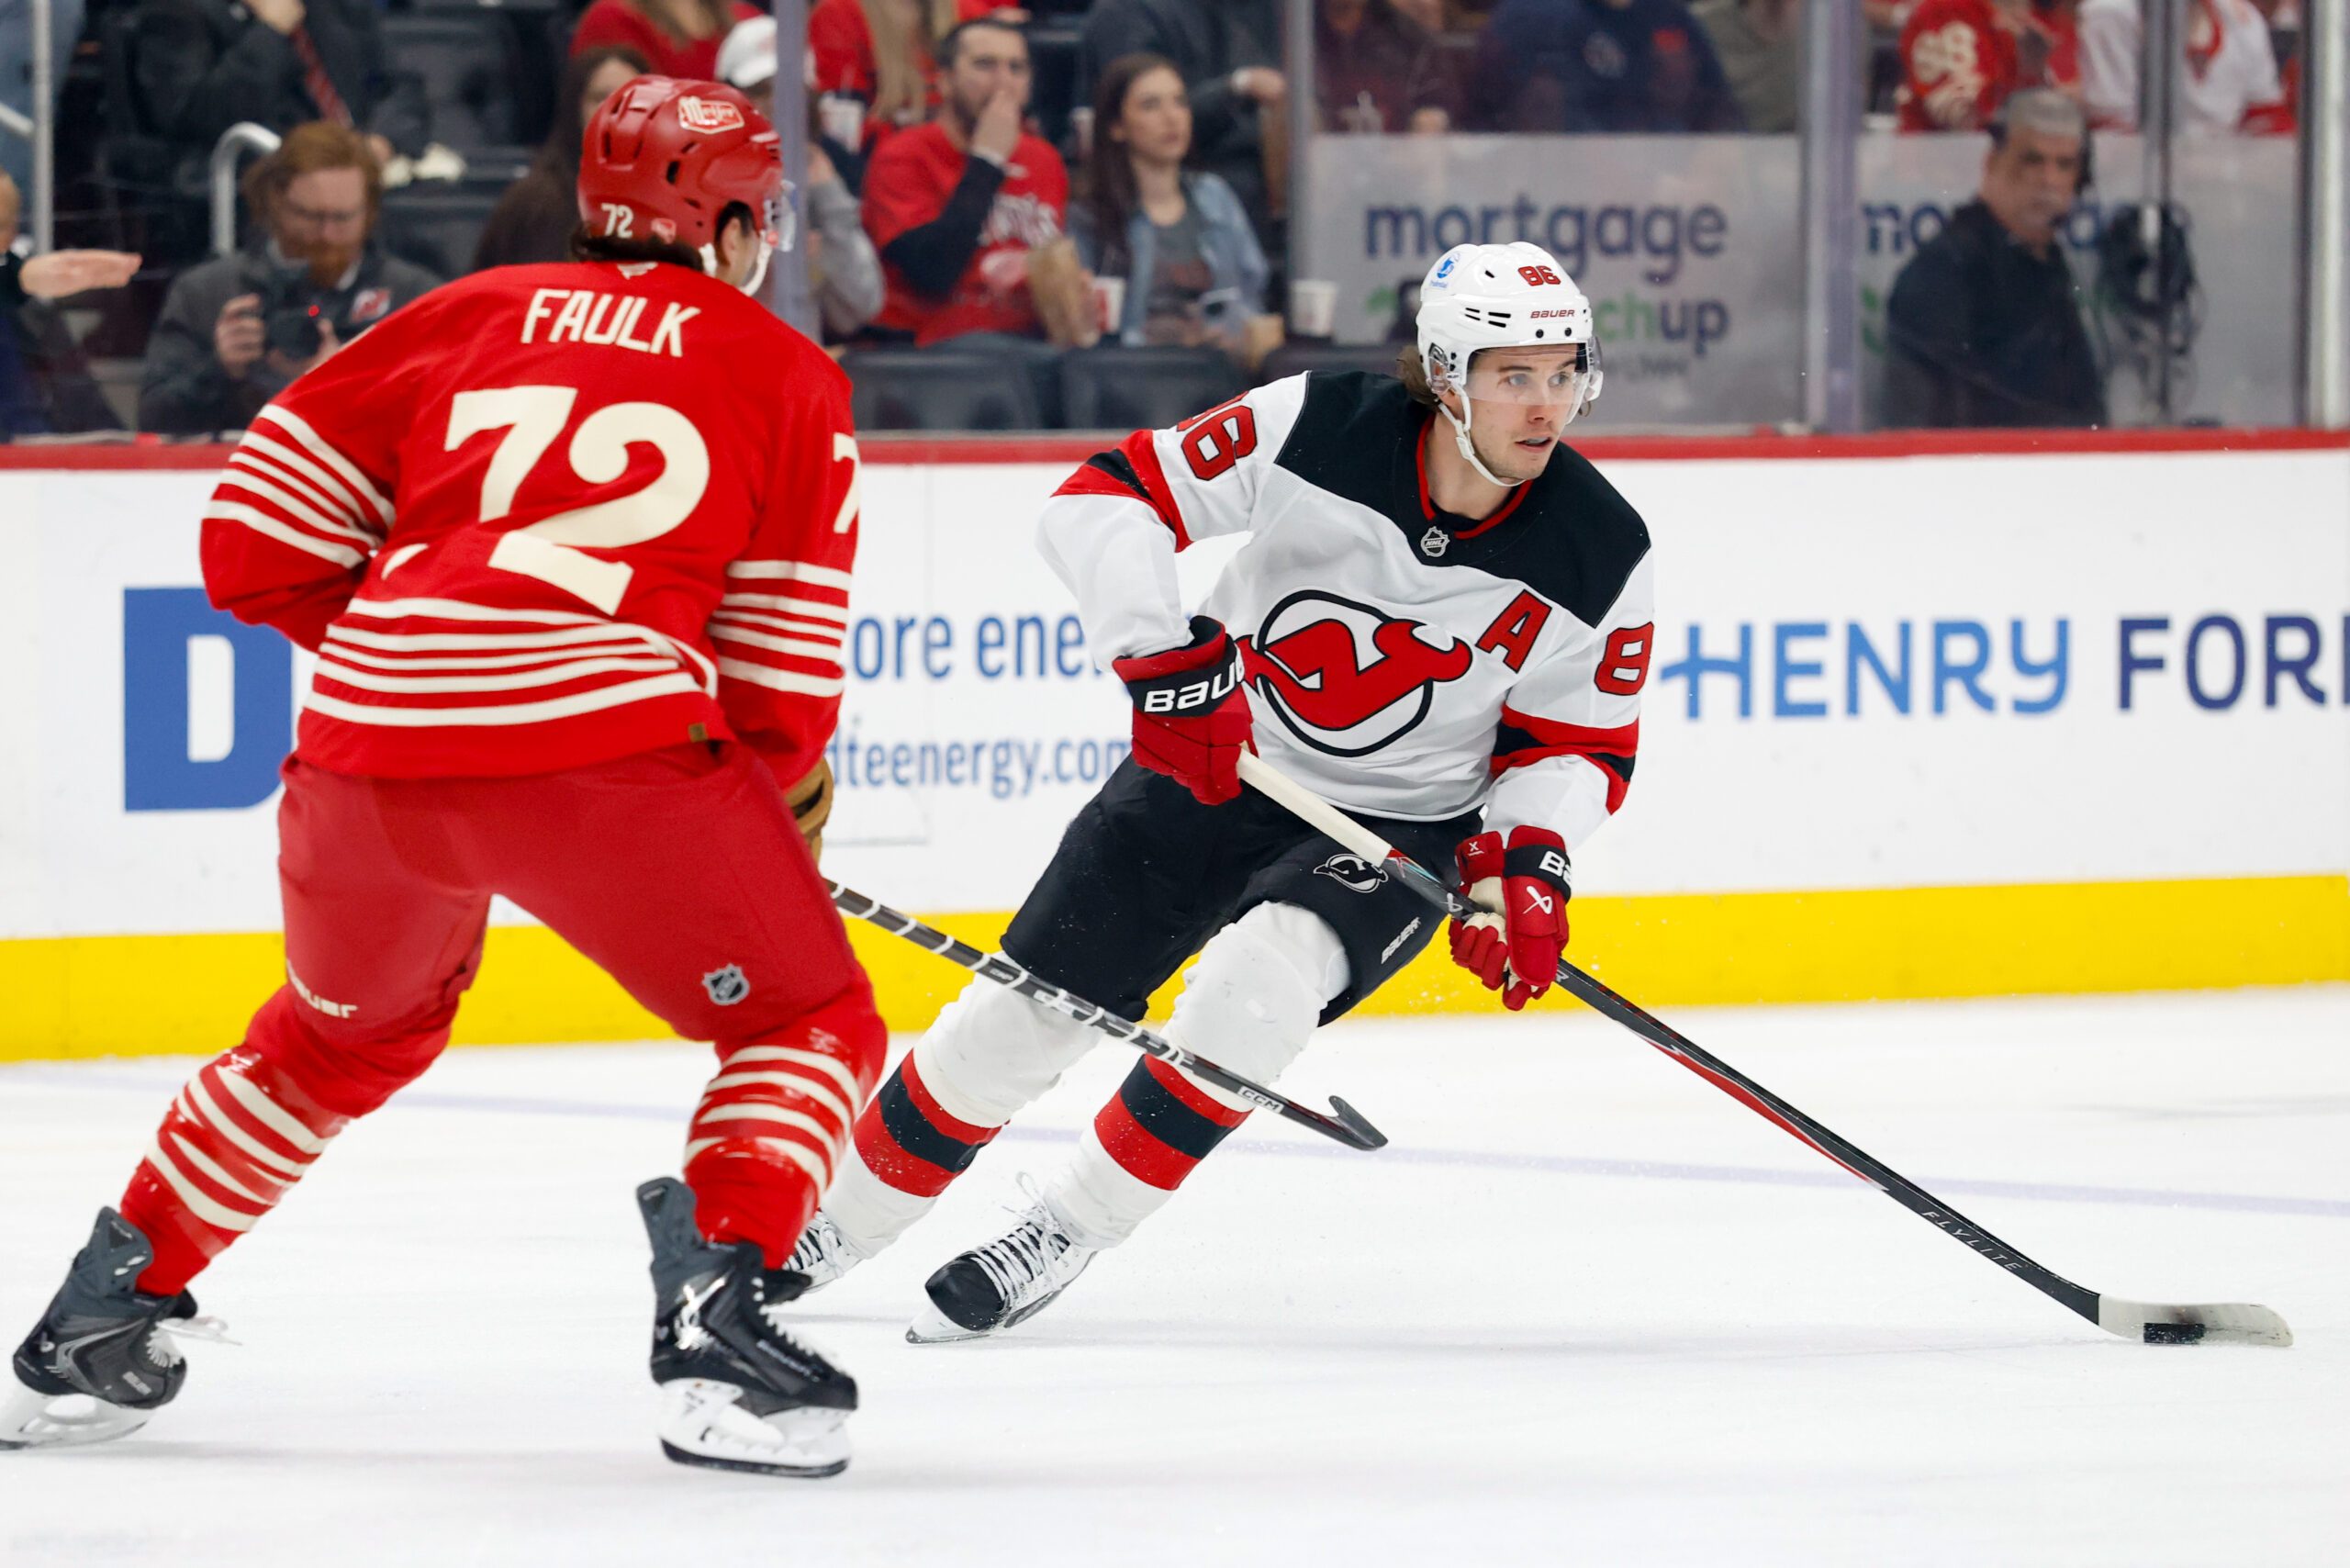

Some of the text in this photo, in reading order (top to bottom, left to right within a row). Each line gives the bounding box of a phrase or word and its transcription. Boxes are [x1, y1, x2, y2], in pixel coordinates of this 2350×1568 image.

[601, 202, 633, 239] 72
[1365, 193, 1728, 286] mortgage
[520, 287, 701, 358] FAULK
[1595, 290, 1732, 357] chup
[1176, 390, 1258, 481] 6
[444, 385, 711, 617] 72
[853, 614, 1104, 681] ore ene
[1475, 588, 1552, 674] A
[1594, 621, 1654, 696] 8
[1660, 613, 2350, 720] HENRY FOR
[1241, 1090, 1280, 1111] CCM
[1921, 1210, 2022, 1271] FLYLITE
